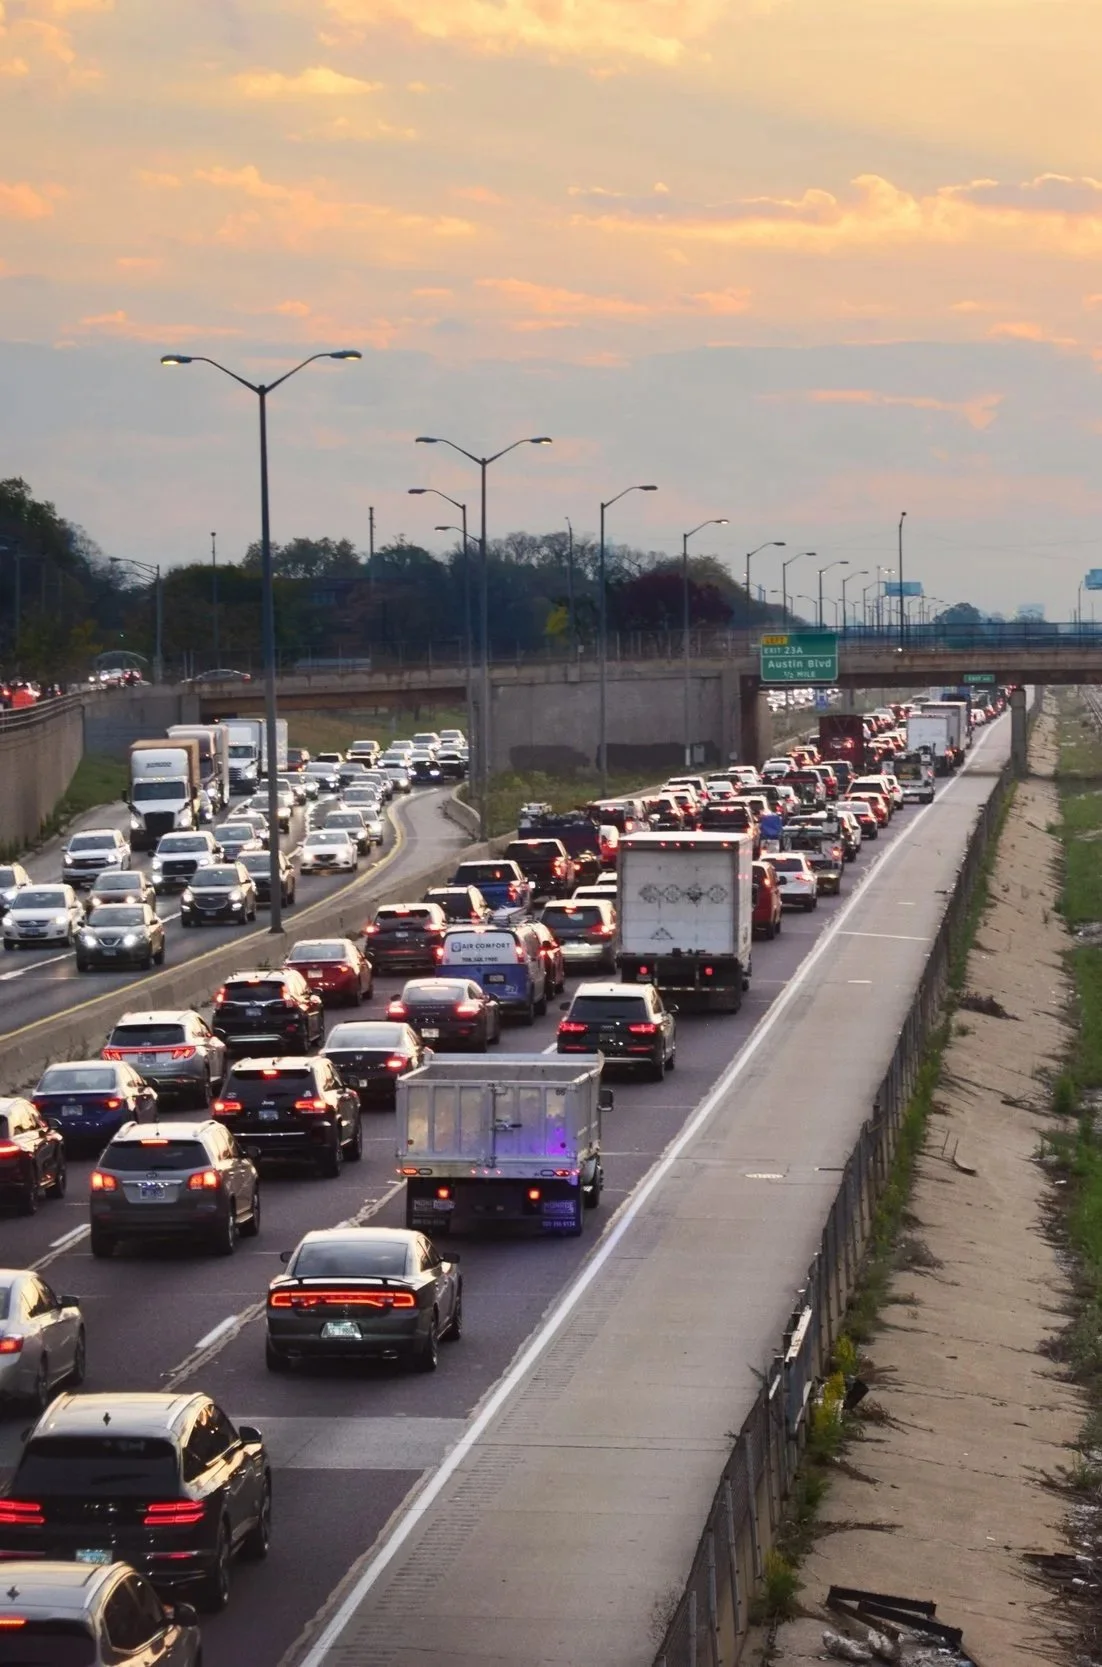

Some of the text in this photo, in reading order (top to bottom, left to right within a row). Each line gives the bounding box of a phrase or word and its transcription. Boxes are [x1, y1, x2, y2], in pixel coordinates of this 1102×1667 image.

[784, 646, 803, 654] 23A
[768, 659, 832, 669] Austin Blvd
